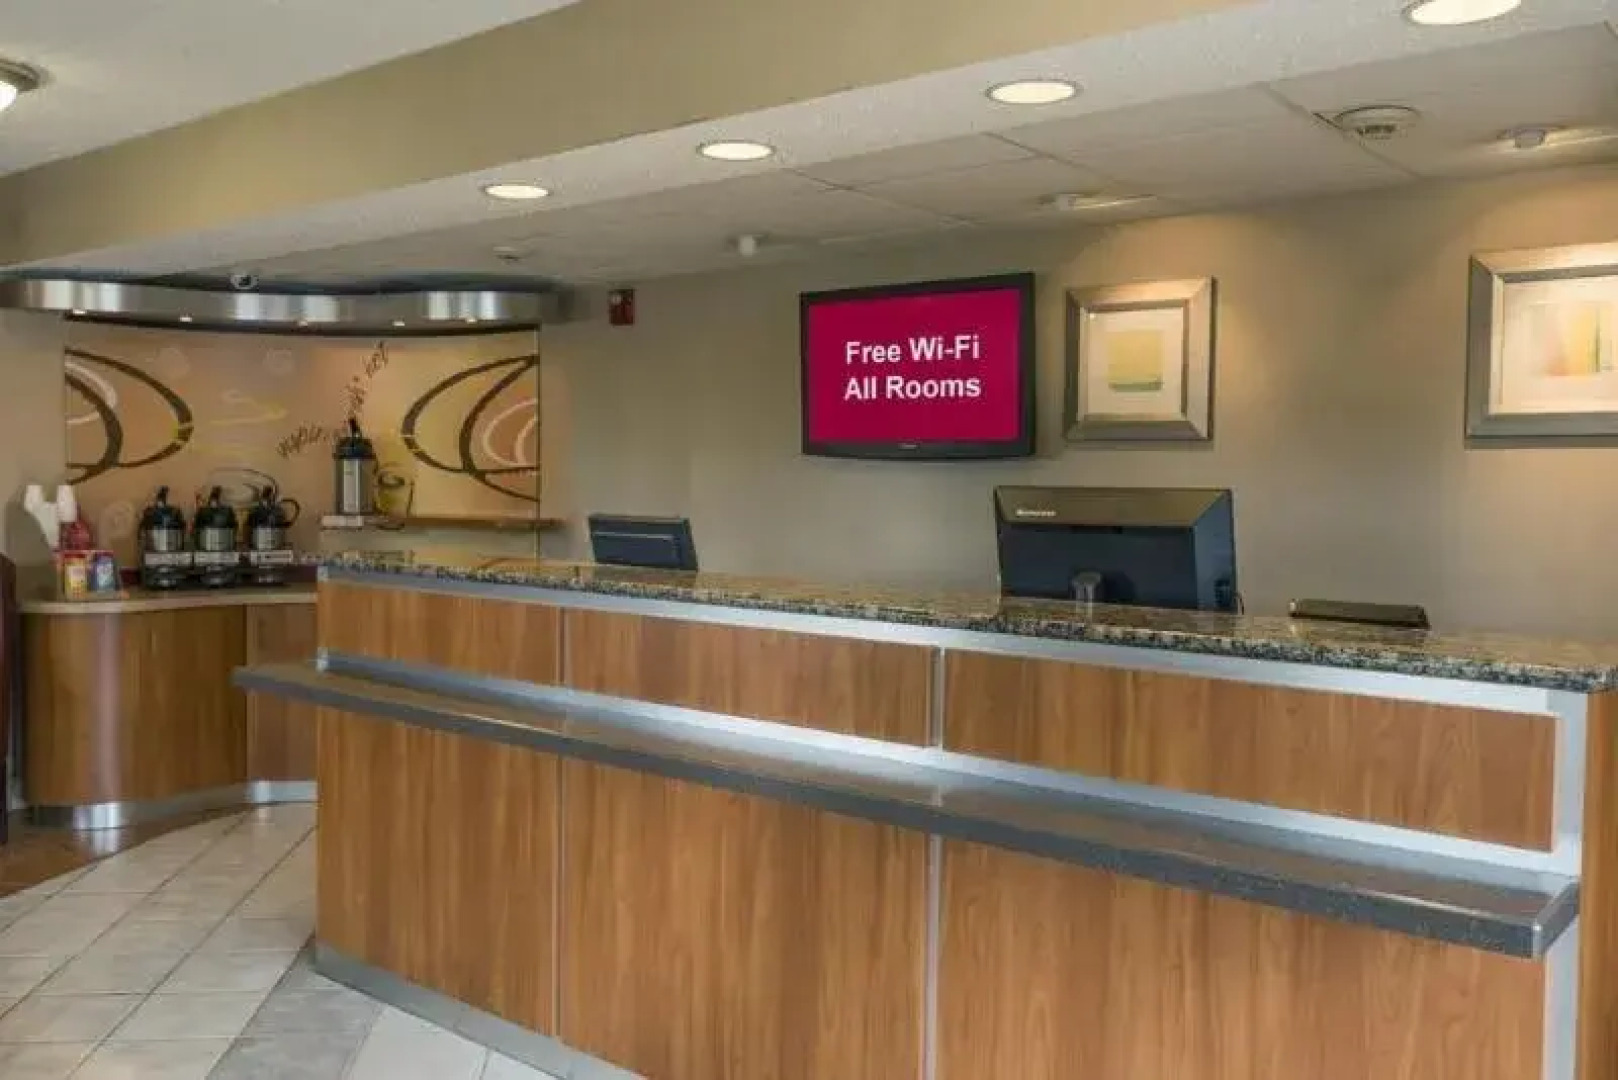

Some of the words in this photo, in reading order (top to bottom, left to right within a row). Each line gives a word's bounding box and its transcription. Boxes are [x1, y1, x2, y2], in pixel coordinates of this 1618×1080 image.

[846, 341, 901, 364] Free
[909, 334, 980, 361] Wi-Fi
[844, 375, 877, 400] All
[885, 375, 982, 399] Rooms
